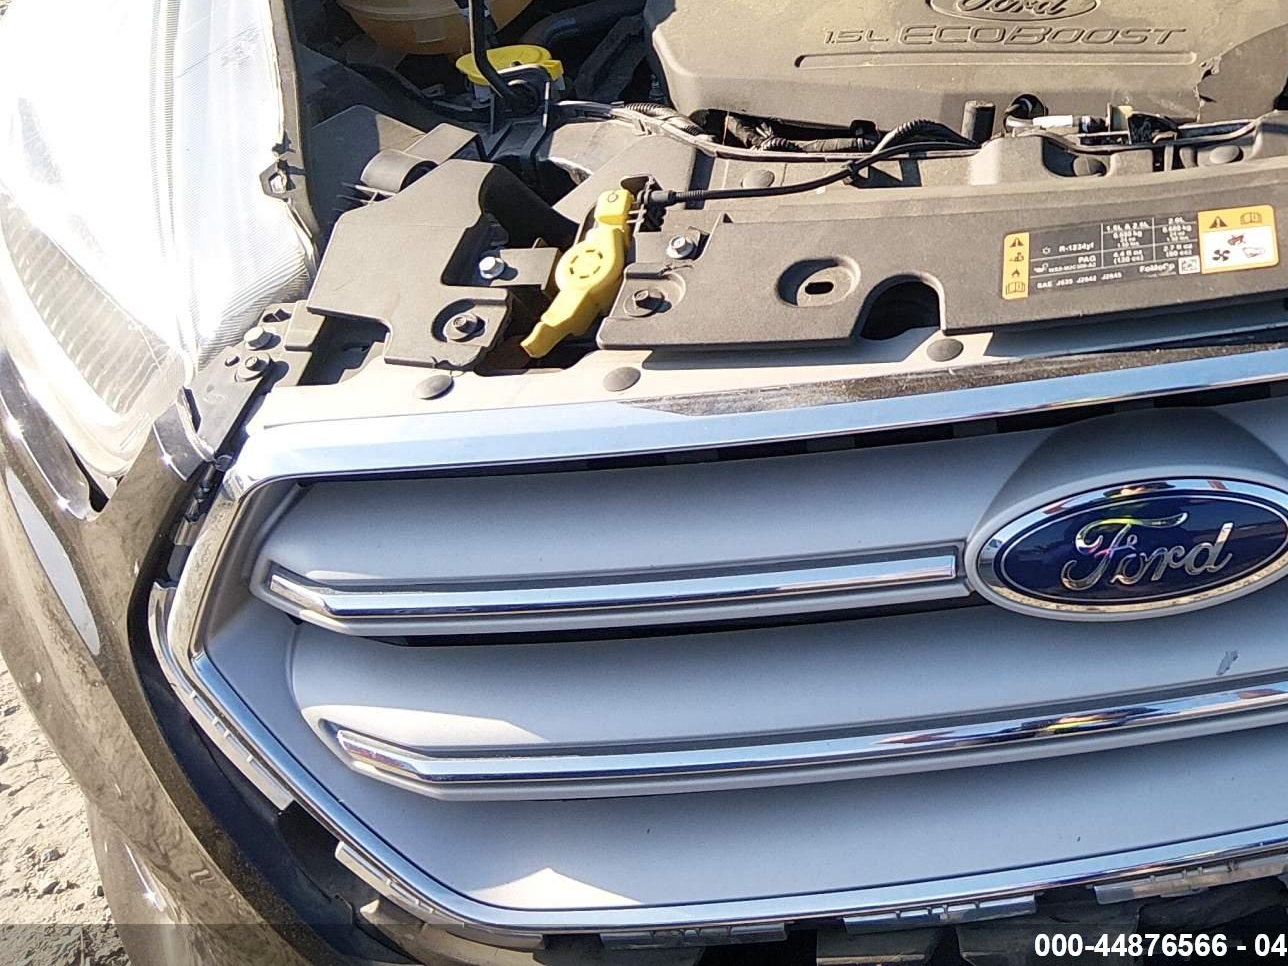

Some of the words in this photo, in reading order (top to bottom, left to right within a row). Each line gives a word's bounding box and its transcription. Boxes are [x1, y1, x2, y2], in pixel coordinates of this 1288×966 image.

[824, 27, 888, 44] 1.5L
[899, 24, 1187, 46] ECOBOOST
[1078, 255, 1096, 264] PAG
[1060, 511, 1234, 591] Ford
